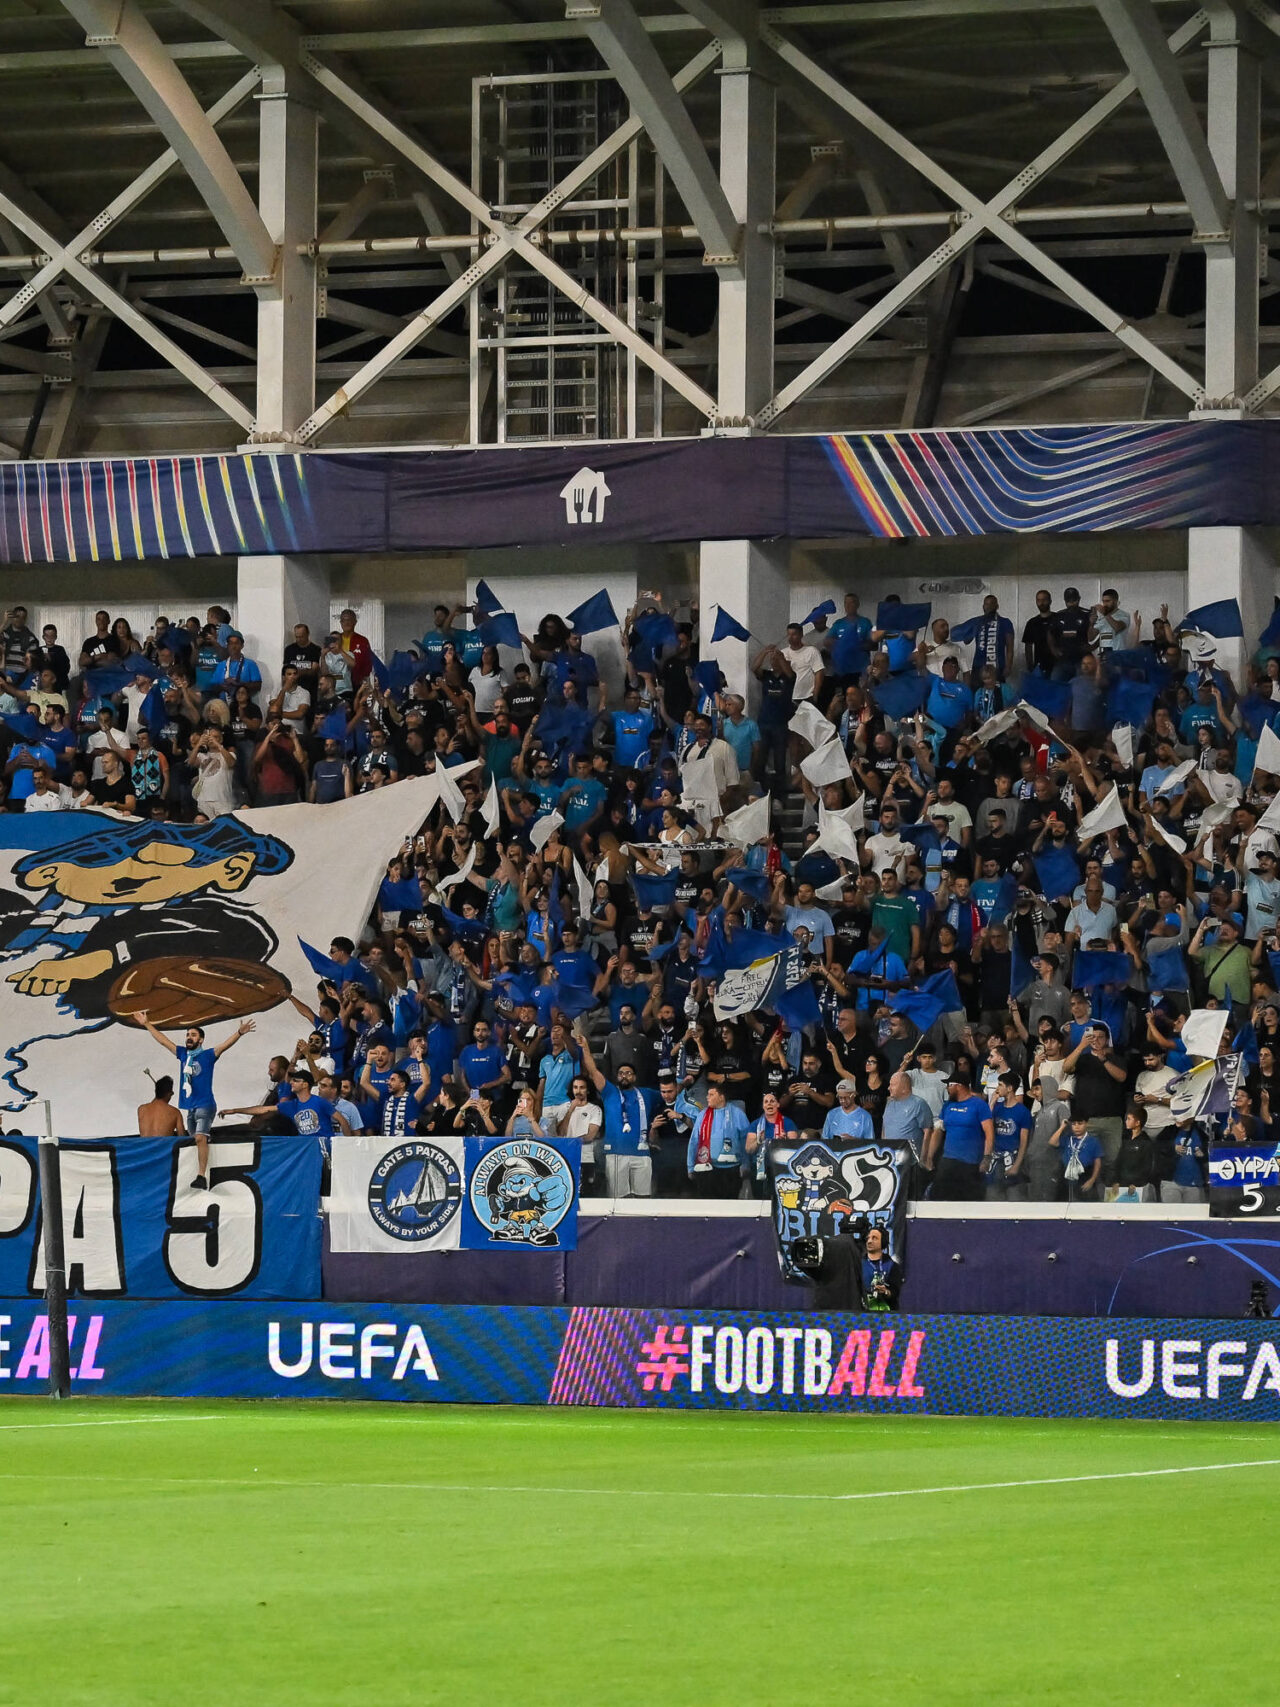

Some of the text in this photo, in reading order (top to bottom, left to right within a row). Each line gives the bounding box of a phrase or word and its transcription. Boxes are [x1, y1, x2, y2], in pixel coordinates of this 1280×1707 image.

[377, 1145, 455, 1177] GATE 5 PATRAS
[475, 1144, 563, 1197] ALWAYS ON WAR
[1218, 1156, 1280, 1180] ΘΥΡΑ
[162, 1141, 262, 1295] 5
[372, 1203, 455, 1236] ALWAYS BY YOUR SIDE
[1239, 1182, 1265, 1212] 5
[268, 1322, 440, 1381] UEFA
[637, 1325, 926, 1398] #FOOTBALL
[1105, 1338, 1280, 1400] UEFA
